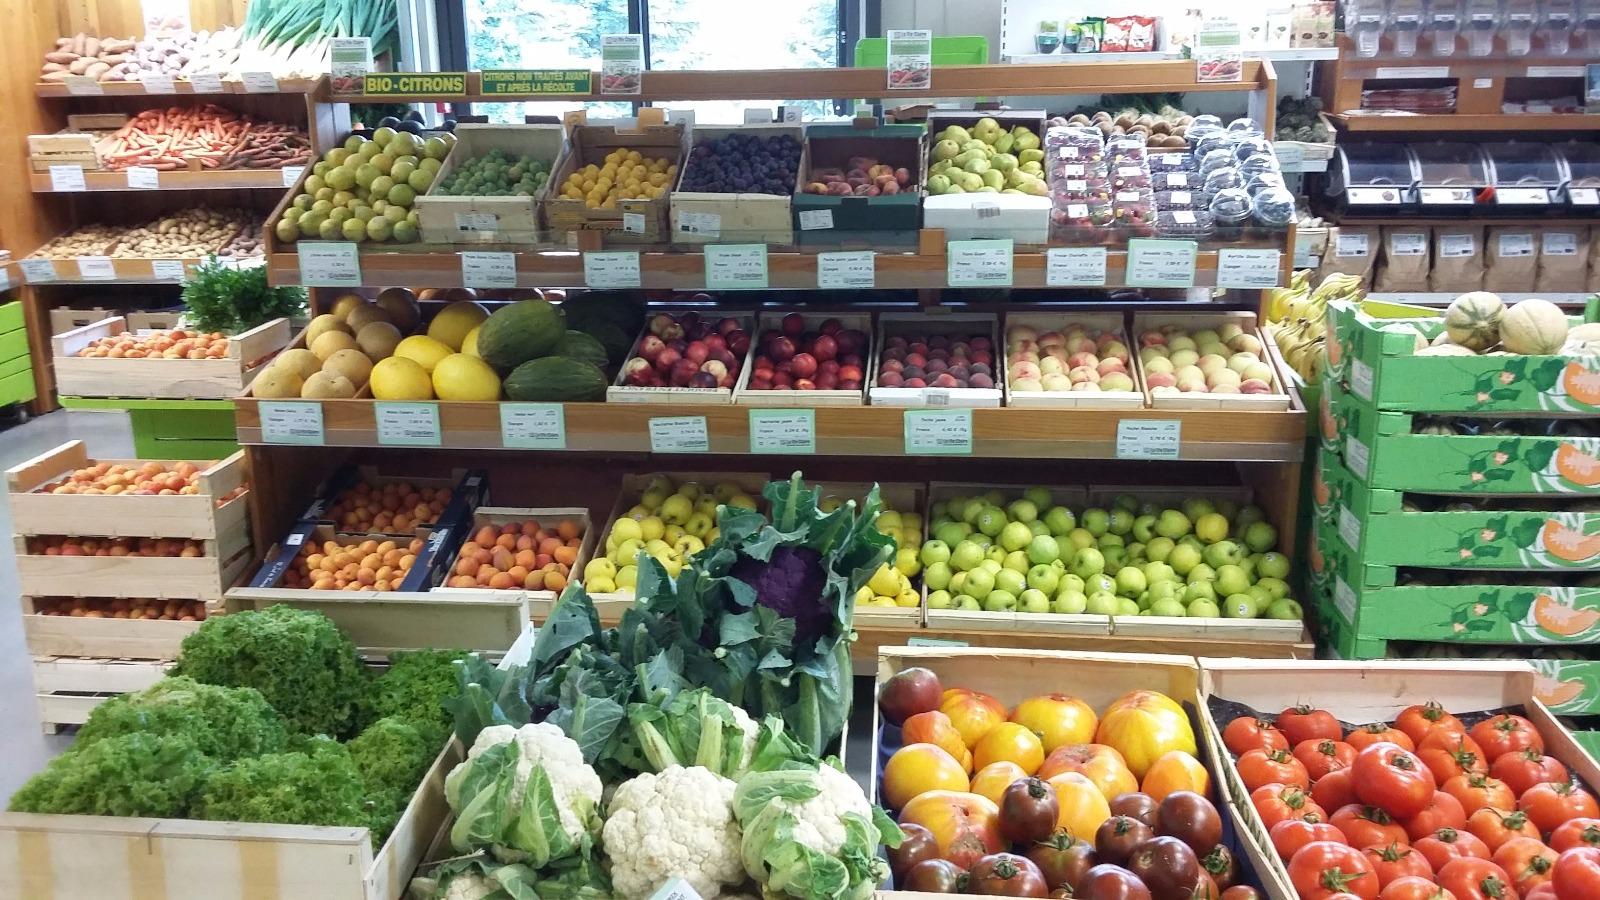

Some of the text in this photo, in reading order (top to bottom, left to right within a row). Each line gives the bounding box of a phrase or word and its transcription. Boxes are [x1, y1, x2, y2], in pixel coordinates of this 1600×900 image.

[483, 72, 515, 81] CITRONS
[516, 72, 532, 81] NON
[564, 71, 589, 80] AVANT
[496, 83, 506, 92] ET
[531, 83, 541, 92] LA
